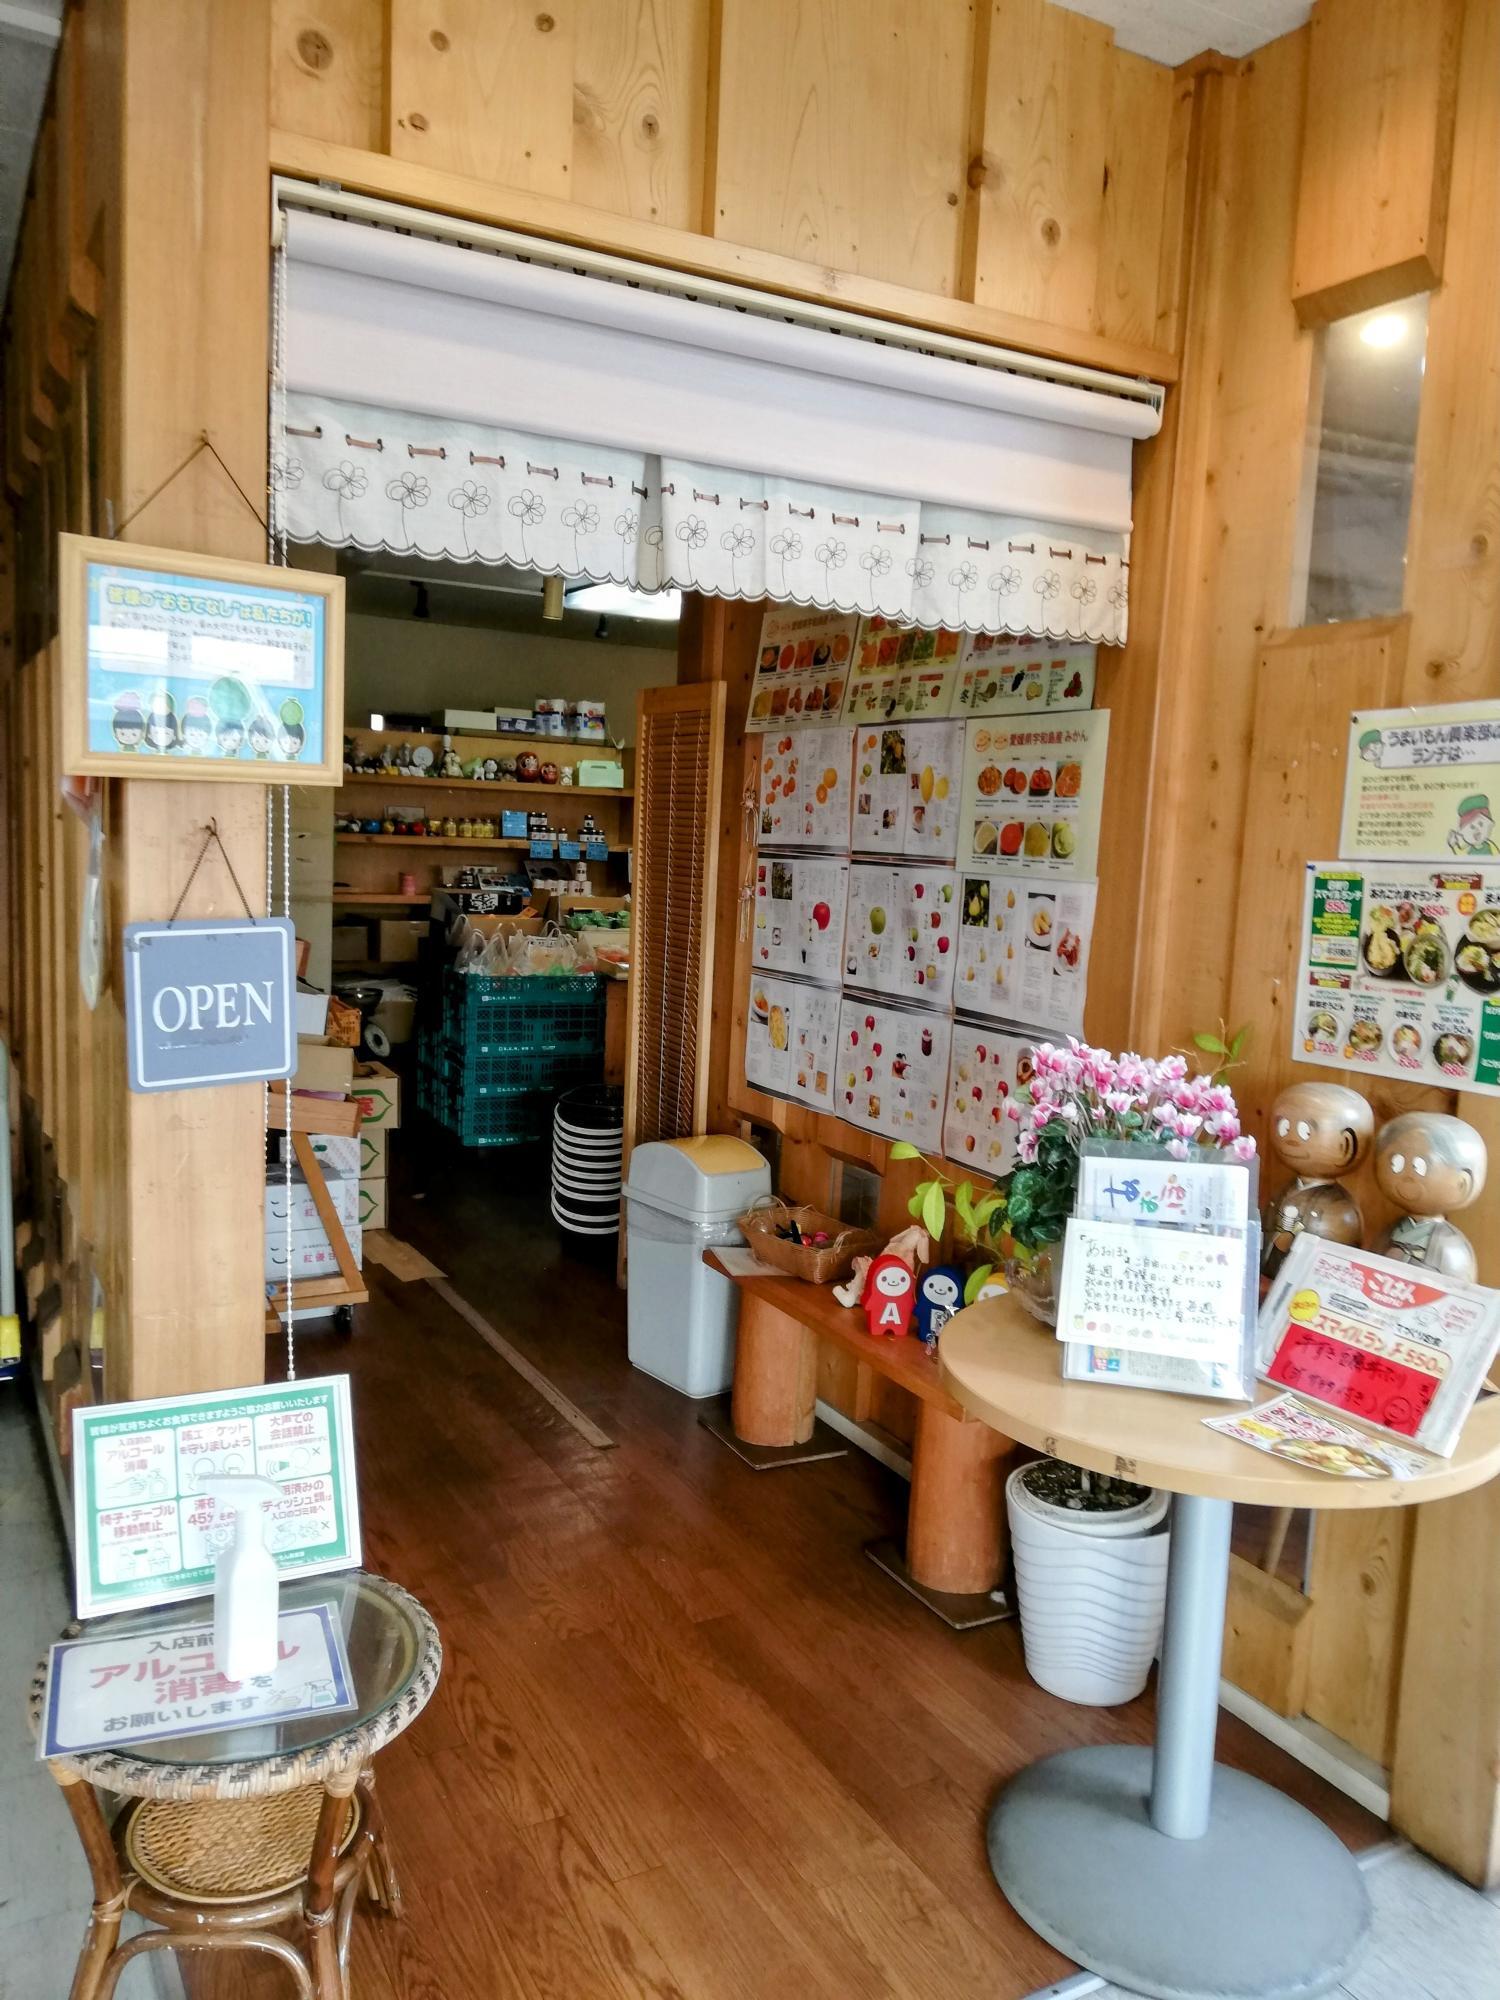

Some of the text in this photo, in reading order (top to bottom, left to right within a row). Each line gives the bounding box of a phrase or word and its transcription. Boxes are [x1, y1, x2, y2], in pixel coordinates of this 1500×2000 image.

[152, 981, 274, 1032] OPEN
[879, 1302, 902, 1325] A
[269, 1412, 314, 1427] 大声での
[270, 1423, 315, 1441] 会話禁止
[106, 1443, 165, 1462] アルコール
[179, 1437, 251, 1456] を守りましょう
[124, 1460, 148, 1473] 消毒
[100, 1505, 175, 1527] 椅子・テーブル
[113, 1521, 163, 1539] 移動禁止
[89, 1640, 301, 1689] アルコル
[103, 1695, 260, 1732] お願いします
